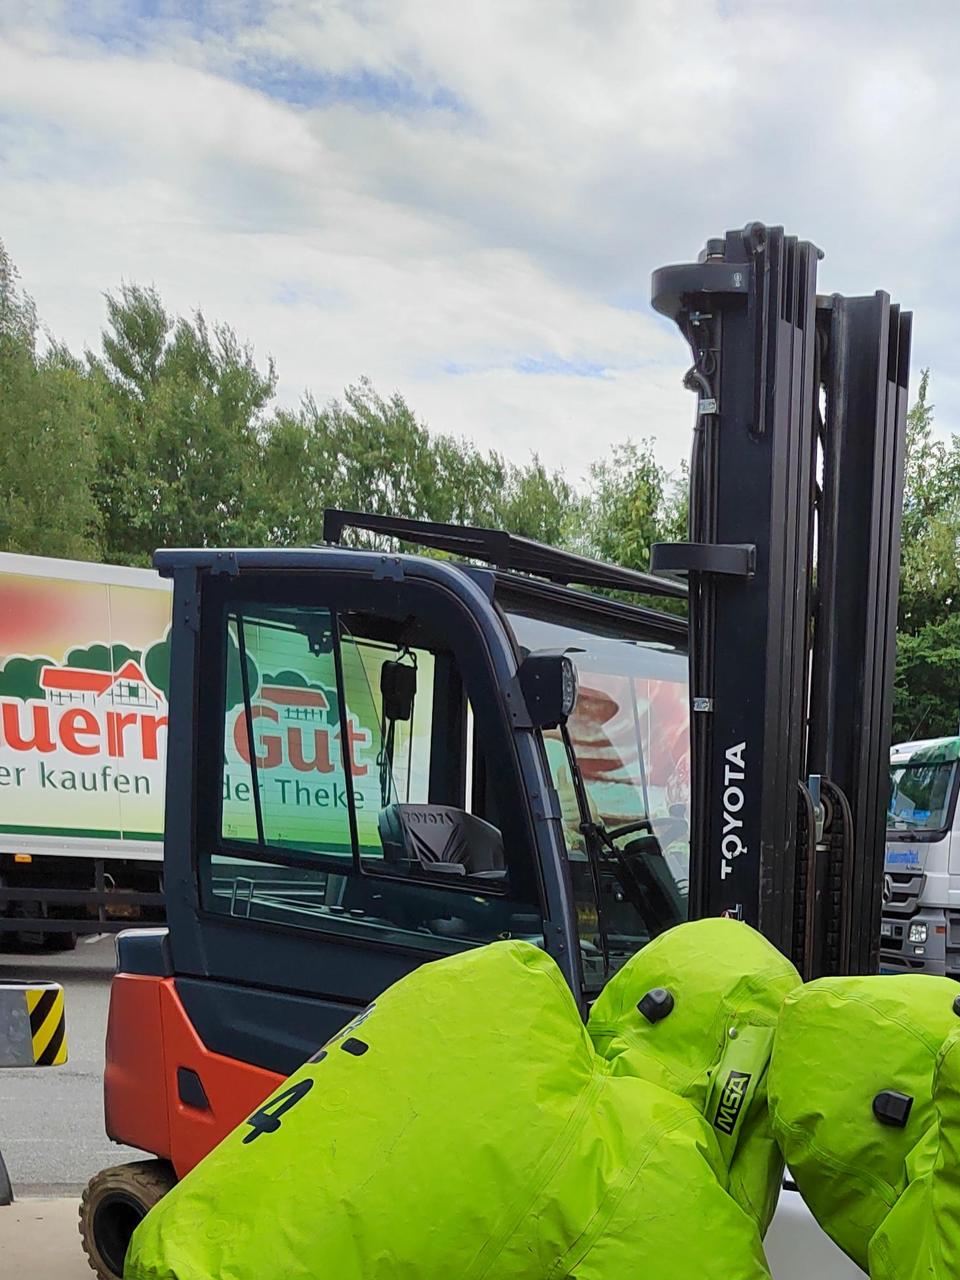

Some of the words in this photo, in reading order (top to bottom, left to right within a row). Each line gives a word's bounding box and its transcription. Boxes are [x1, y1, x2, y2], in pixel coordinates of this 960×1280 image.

[233, 704, 368, 776] Gut
[40, 761, 151, 795] kaufen
[274, 778, 365, 810] Theke
[720, 741, 748, 880] TOYOTA
[715, 1075, 750, 1133] MSA
